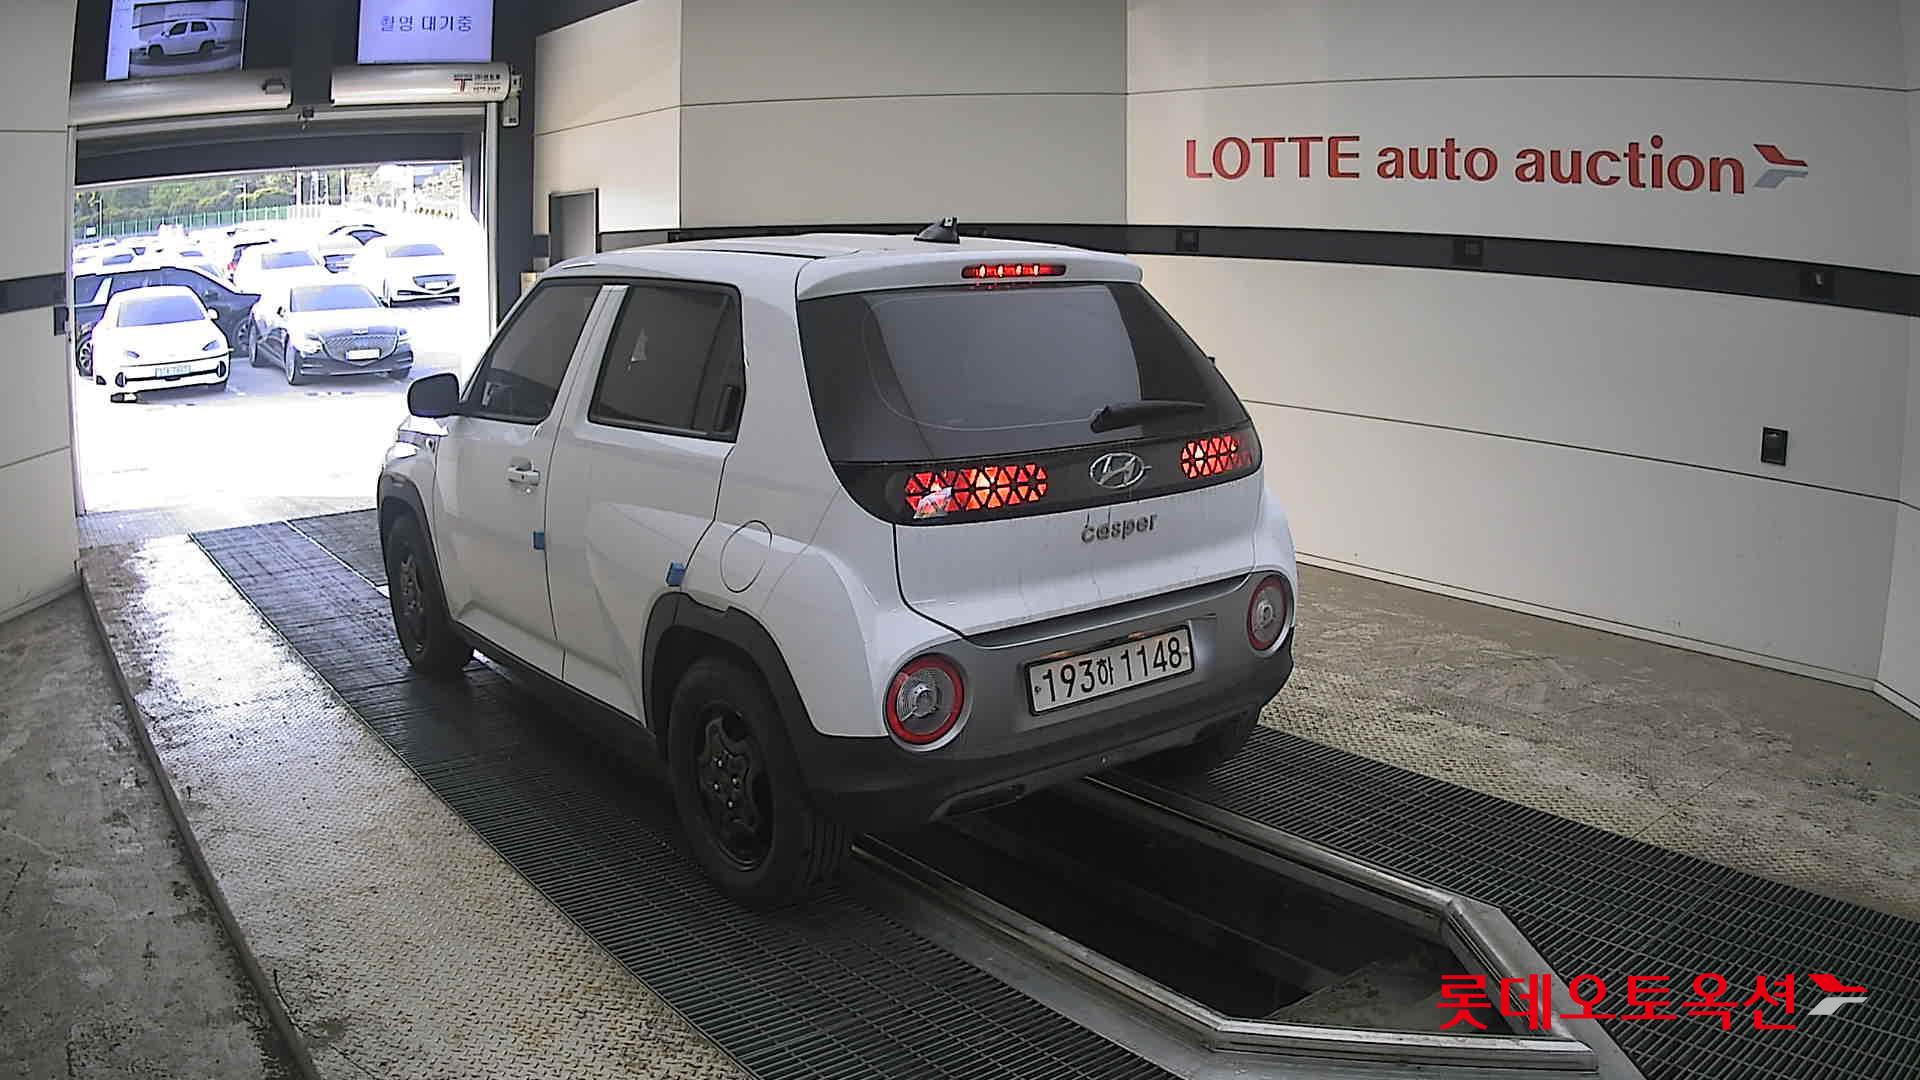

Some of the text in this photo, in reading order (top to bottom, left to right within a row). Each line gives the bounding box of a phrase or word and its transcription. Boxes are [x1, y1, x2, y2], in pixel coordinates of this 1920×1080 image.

[422, 15, 472, 32] 대기중
[1185, 135, 1745, 194] LOTTE auto auction
[1081, 513, 1158, 543] casper
[1042, 636, 1182, 702] 193하 1148
